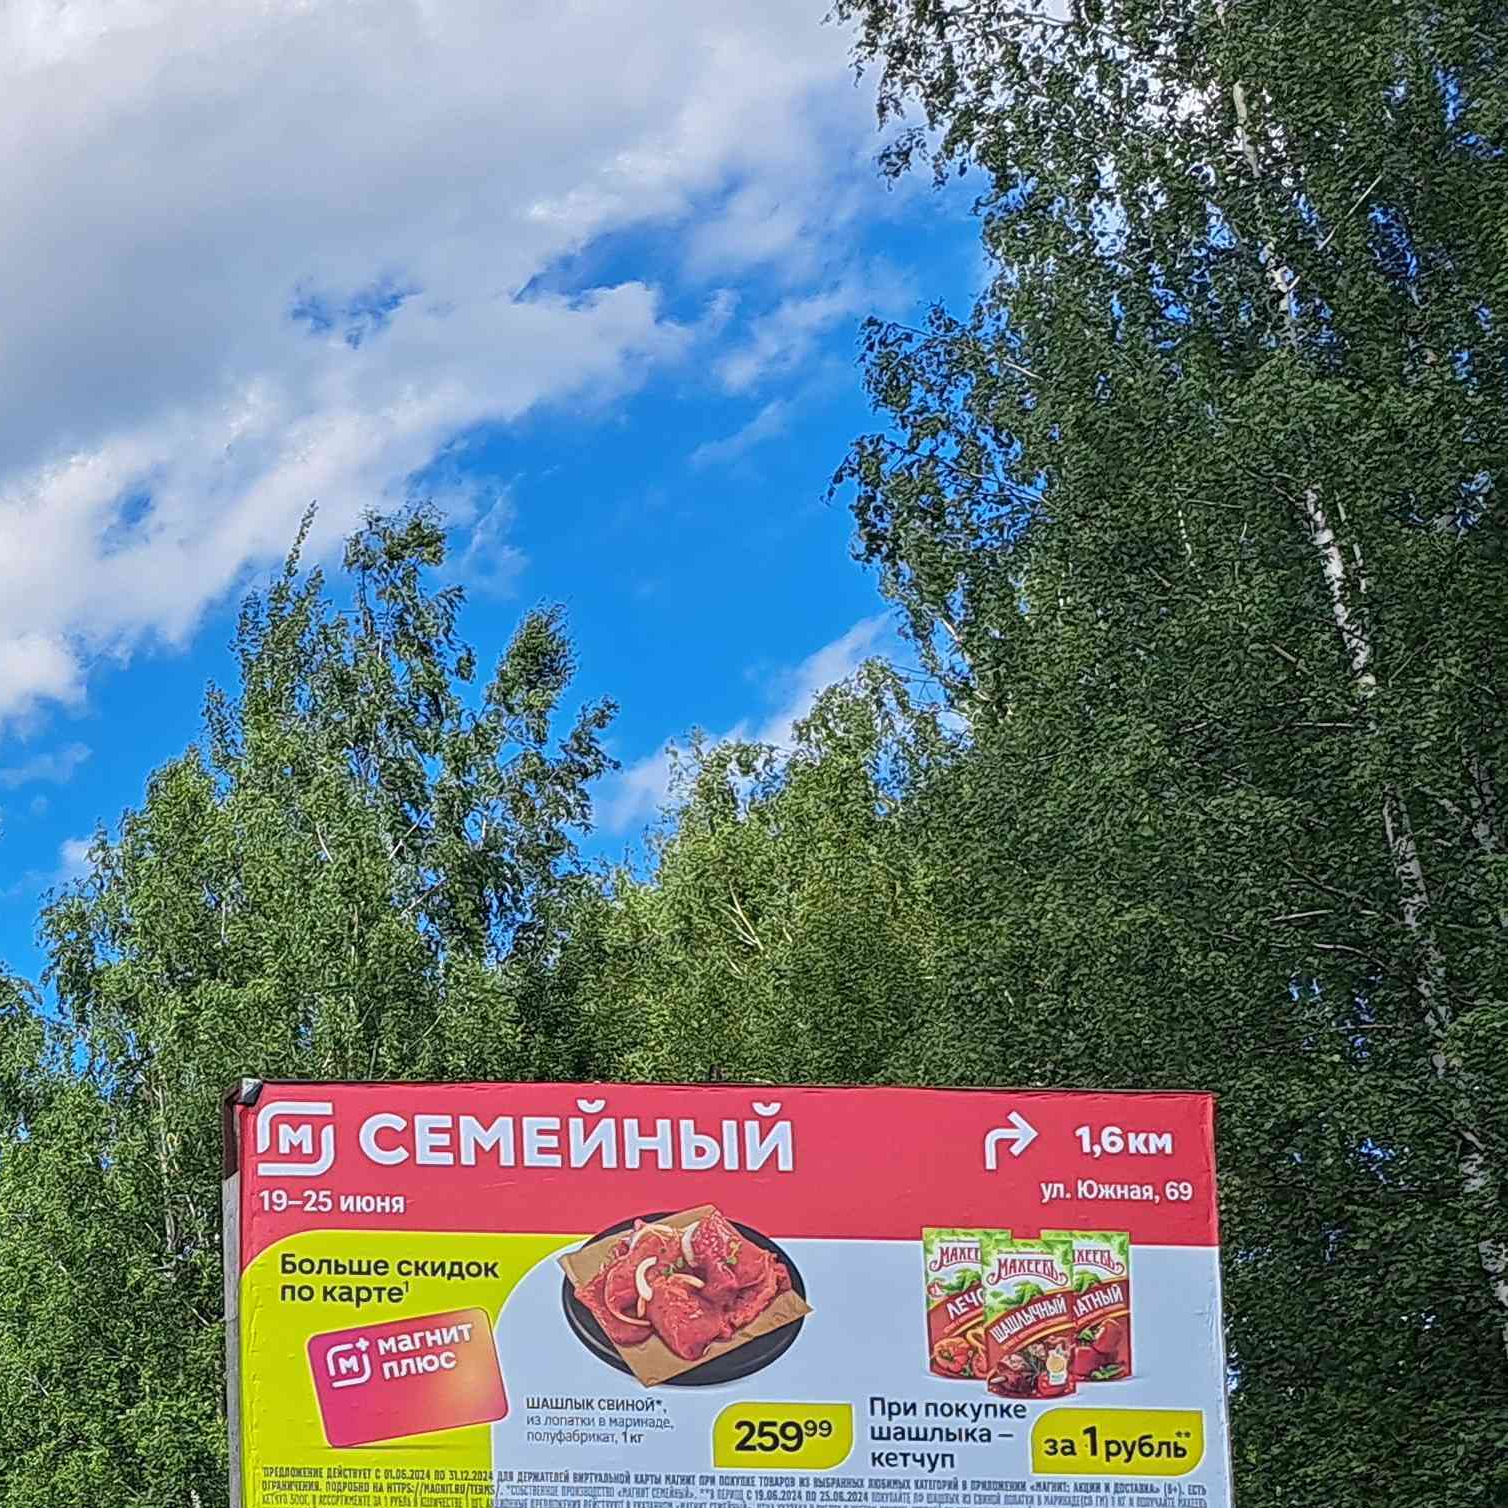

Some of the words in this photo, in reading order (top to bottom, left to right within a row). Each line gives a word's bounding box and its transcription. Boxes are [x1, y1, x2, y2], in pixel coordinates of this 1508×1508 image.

[358, 1098, 795, 1172] СЕМЕЙНЫЙ
[1075, 1125, 1125, 1158] 1,6
[1128, 1132, 1173, 1155] км
[1040, 1181, 1071, 1203] ул.
[1077, 1179, 1161, 1203] Южная,
[1165, 1181, 1194, 1201] 69
[339, 1193, 407, 1215] июня
[280, 1253, 390, 1277] Больше
[397, 1259, 501, 1281] скидок
[280, 1284, 316, 1302] по
[990, 1295, 1068, 1344] ШАШЛЫЧНЫЙ
[377, 1323, 473, 1356] магнит
[382, 1351, 458, 1381] плюс
[526, 1397, 595, 1411] ШАШЛЫК
[869, 1396, 917, 1420] При
[924, 1400, 1028, 1423] покупке
[526, 1416, 541, 1427] из
[543, 1416, 597, 1428] лопатки
[599, 1417, 607, 1427] в
[609, 1417, 675, 1430] маринаде,
[870, 1424, 993, 1444] шашлыка
[526, 1430, 619, 1446] полуфабрикат,
[621, 1431, 628, 1444] 1
[629, 1433, 644, 1445] кг
[1043, 1437, 1077, 1457] за
[1082, 1426, 1098, 1457] 1
[870, 1450, 956, 1473] кетчуп
